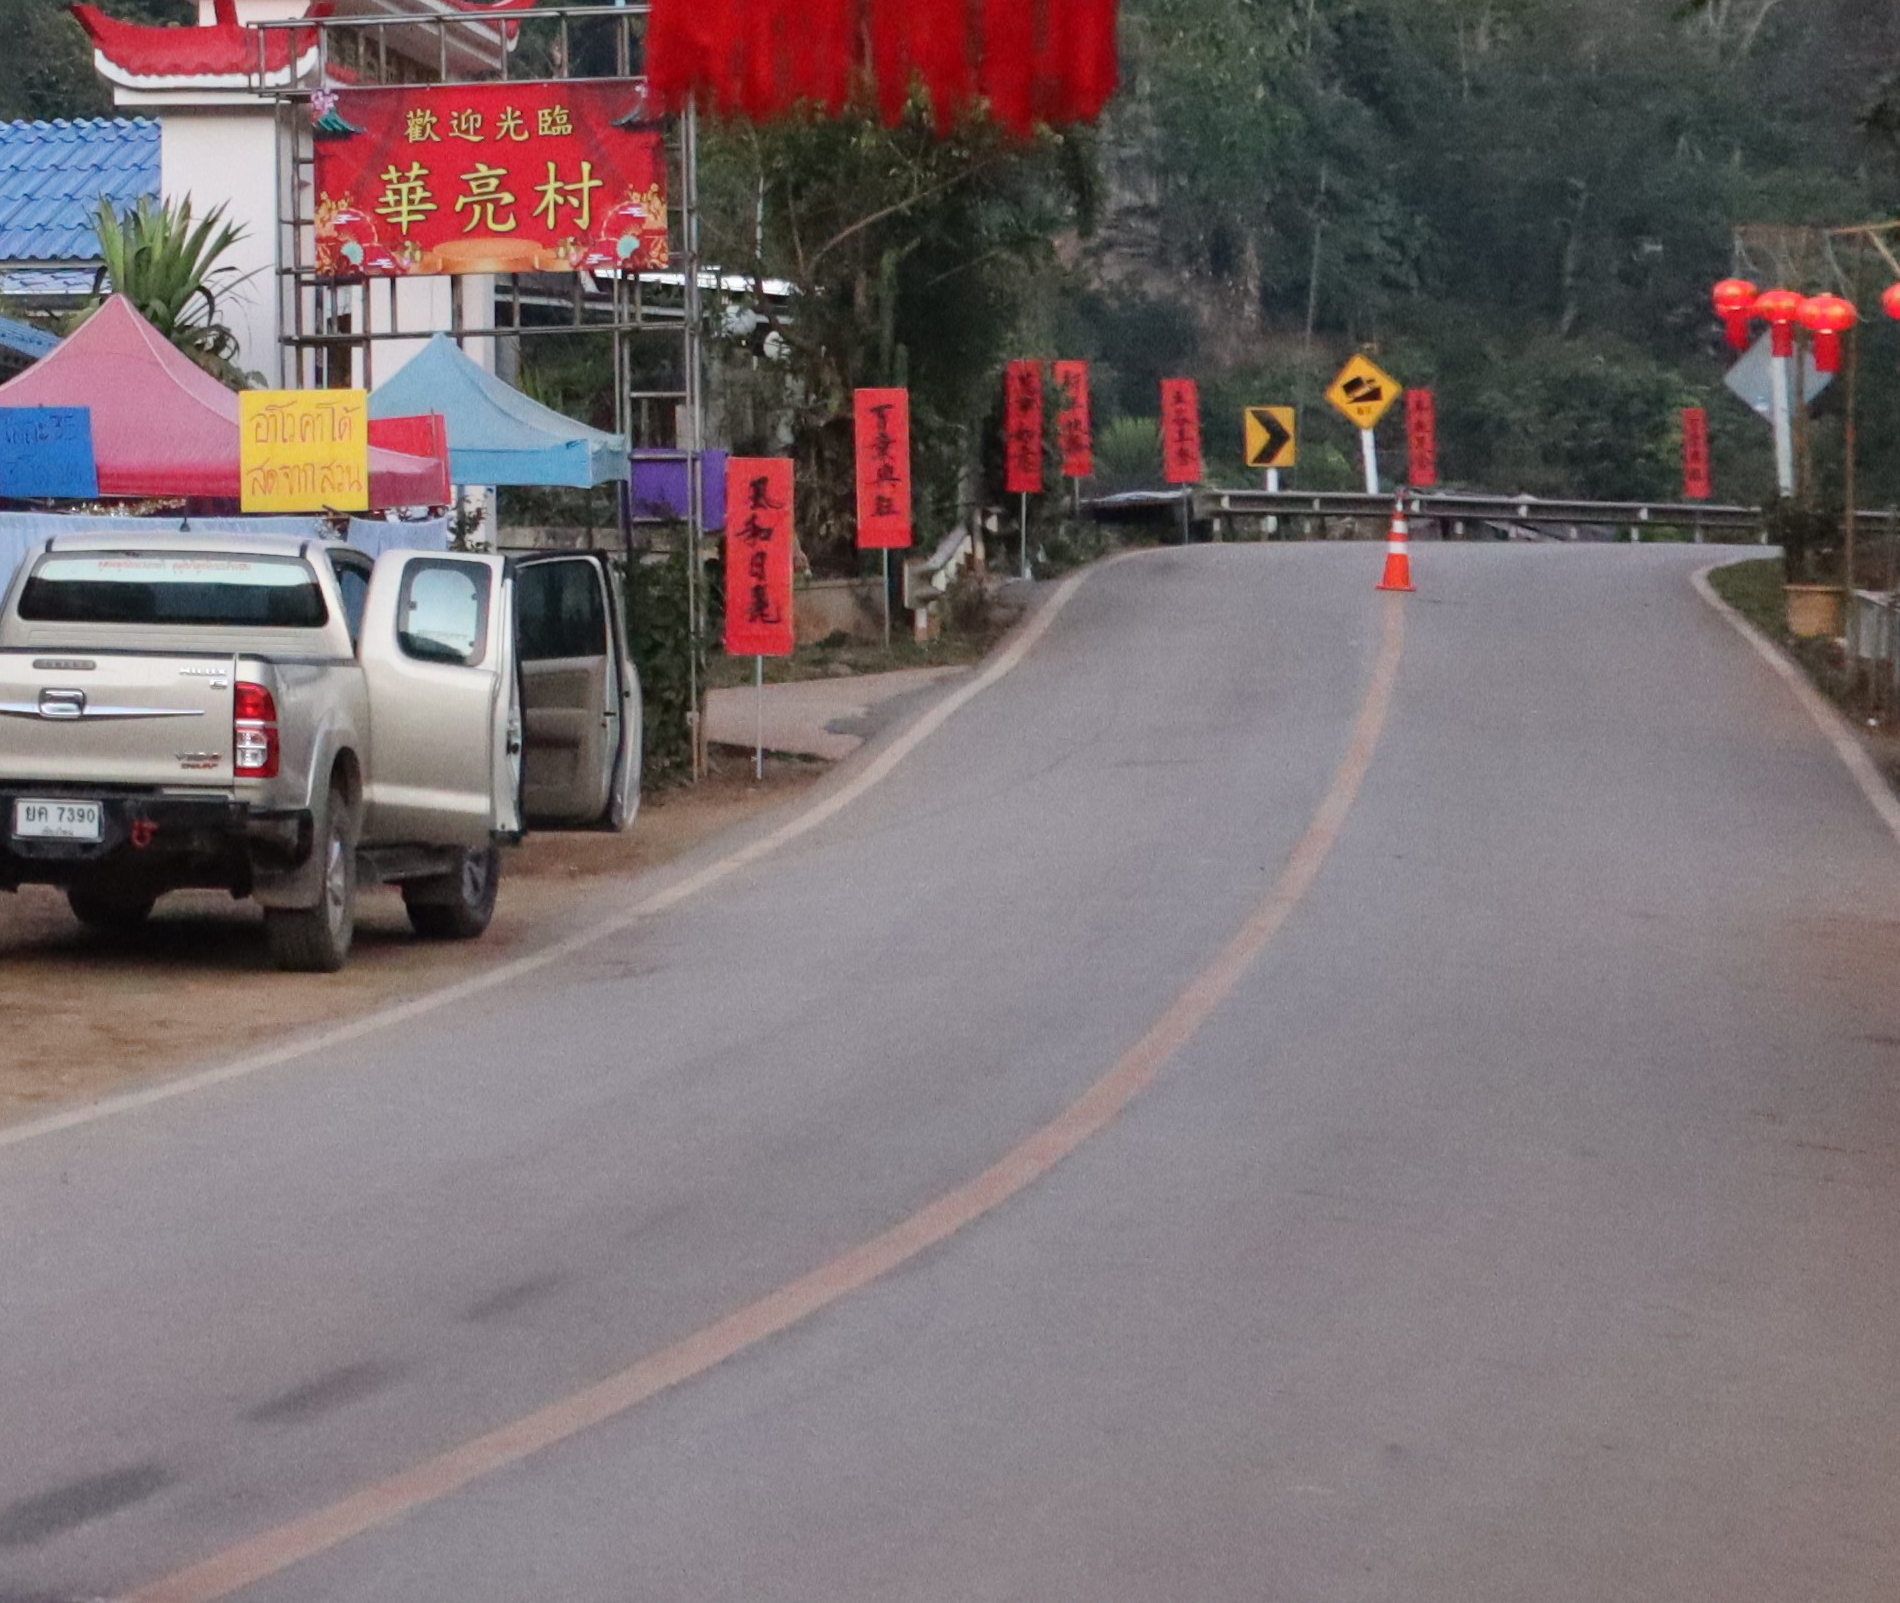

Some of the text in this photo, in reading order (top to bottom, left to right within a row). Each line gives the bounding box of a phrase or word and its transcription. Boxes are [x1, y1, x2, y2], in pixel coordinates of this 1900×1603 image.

[404, 104, 574, 144] 歡迎光臨
[374, 161, 604, 235] 華亮村
[56, 806, 96, 824] 7390
